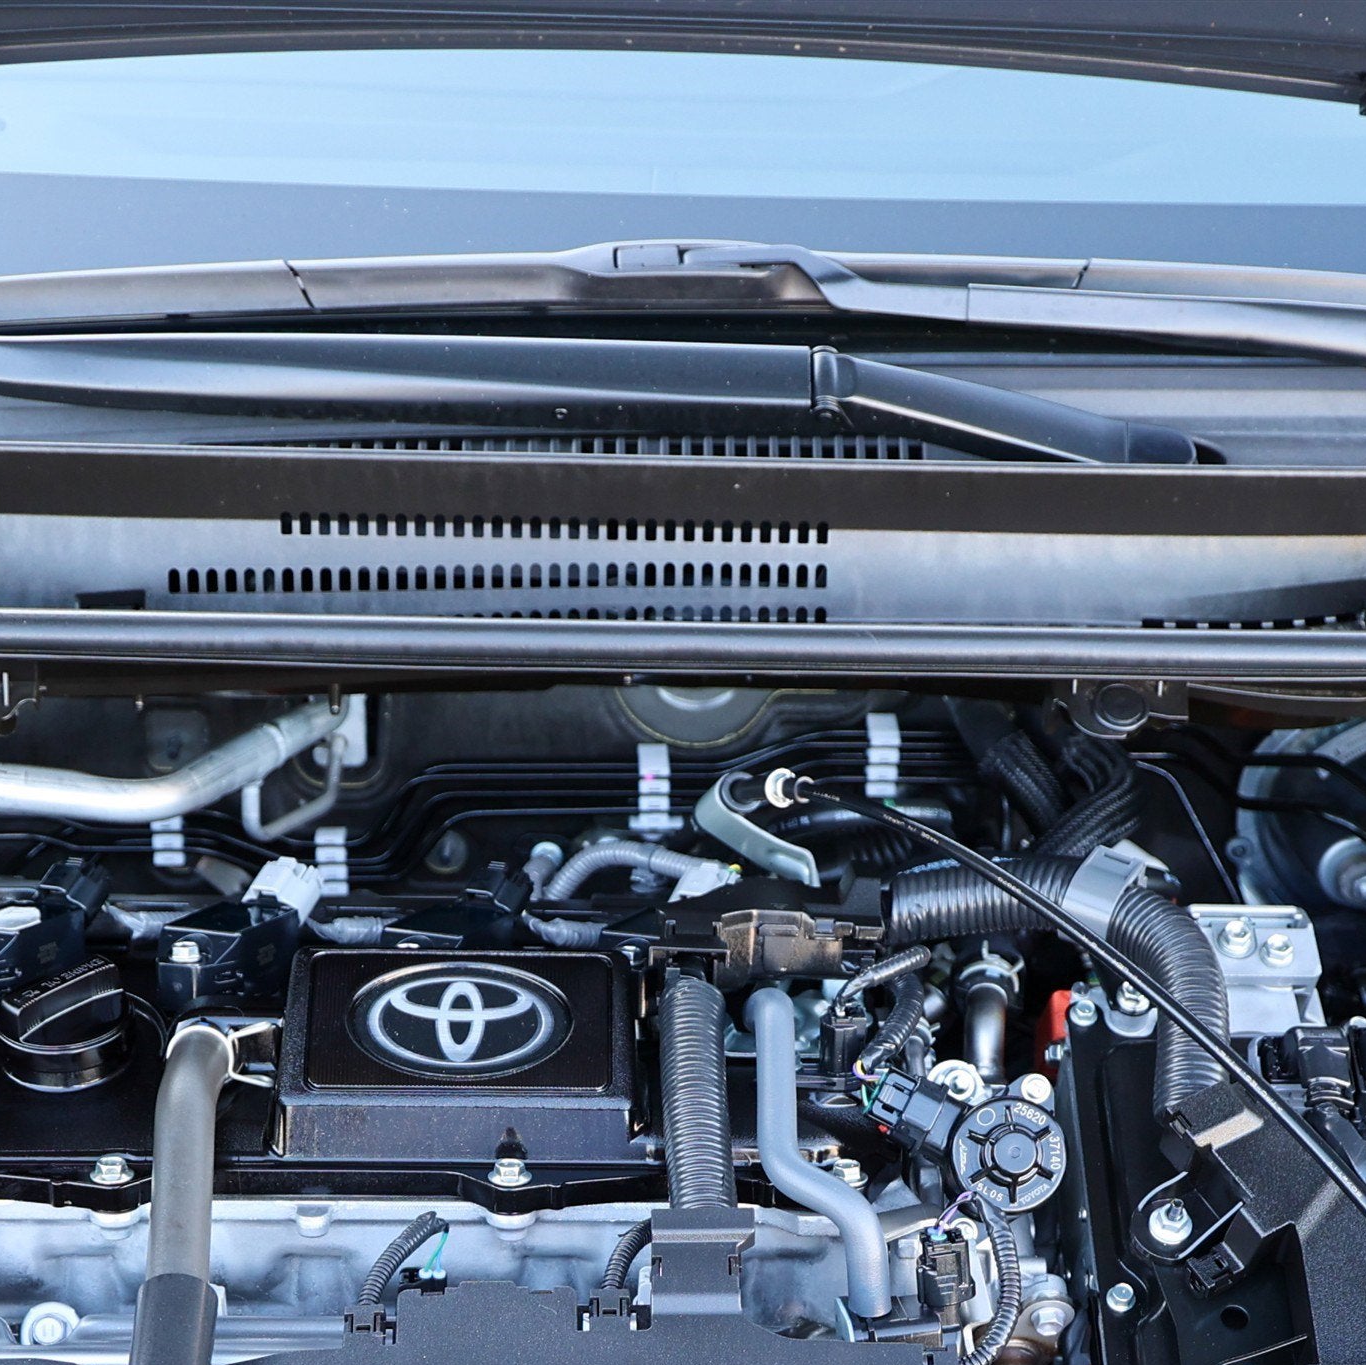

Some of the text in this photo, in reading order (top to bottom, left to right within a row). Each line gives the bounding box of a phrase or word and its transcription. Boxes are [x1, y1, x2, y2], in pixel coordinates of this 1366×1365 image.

[1013, 1102, 1047, 1126] 25620
[1048, 1135, 1062, 1170] 37140
[976, 1183, 1004, 1202] 5L05
[1018, 1183, 1051, 1205] TOYOTA
